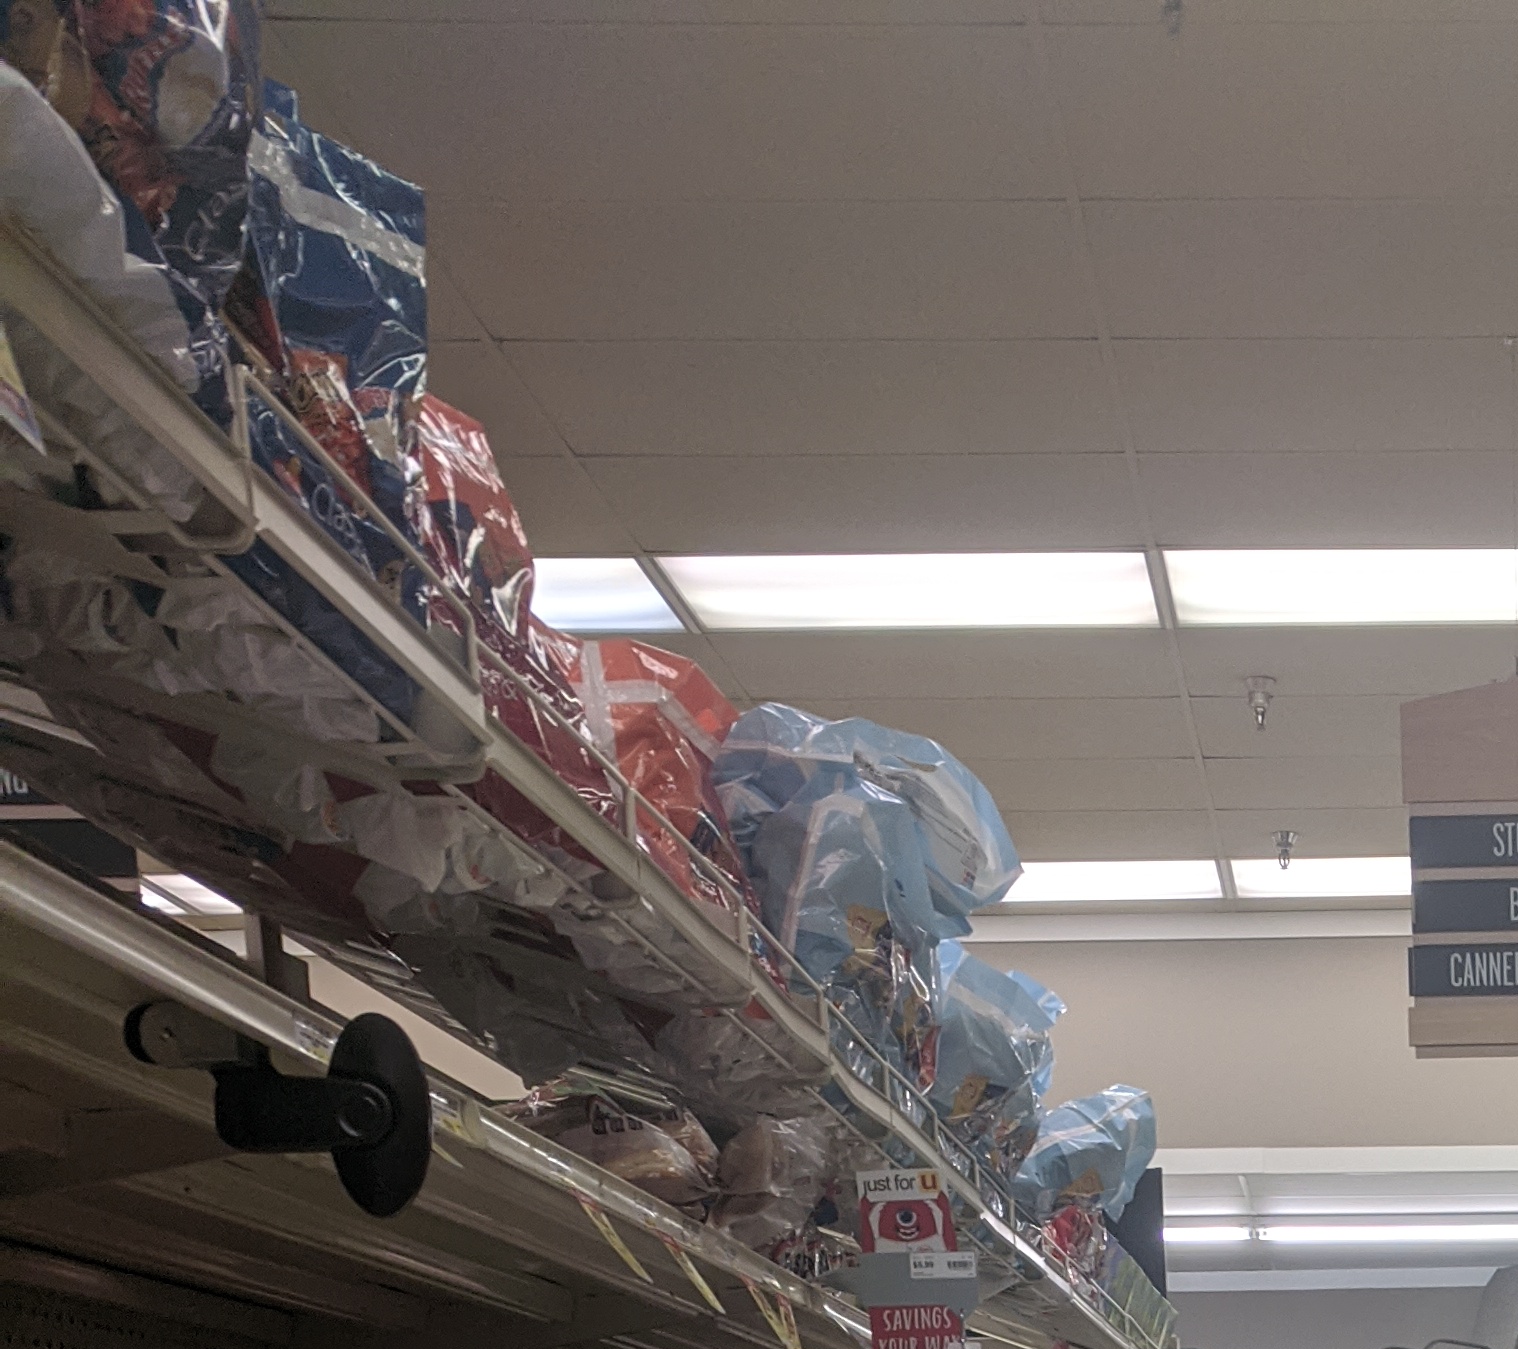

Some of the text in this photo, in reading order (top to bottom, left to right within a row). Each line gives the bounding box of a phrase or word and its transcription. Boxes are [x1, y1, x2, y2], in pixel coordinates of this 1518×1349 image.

[863, 1177, 891, 1197] just
[895, 1174, 916, 1190] for
[883, 1306, 951, 1331] SAVINGS
